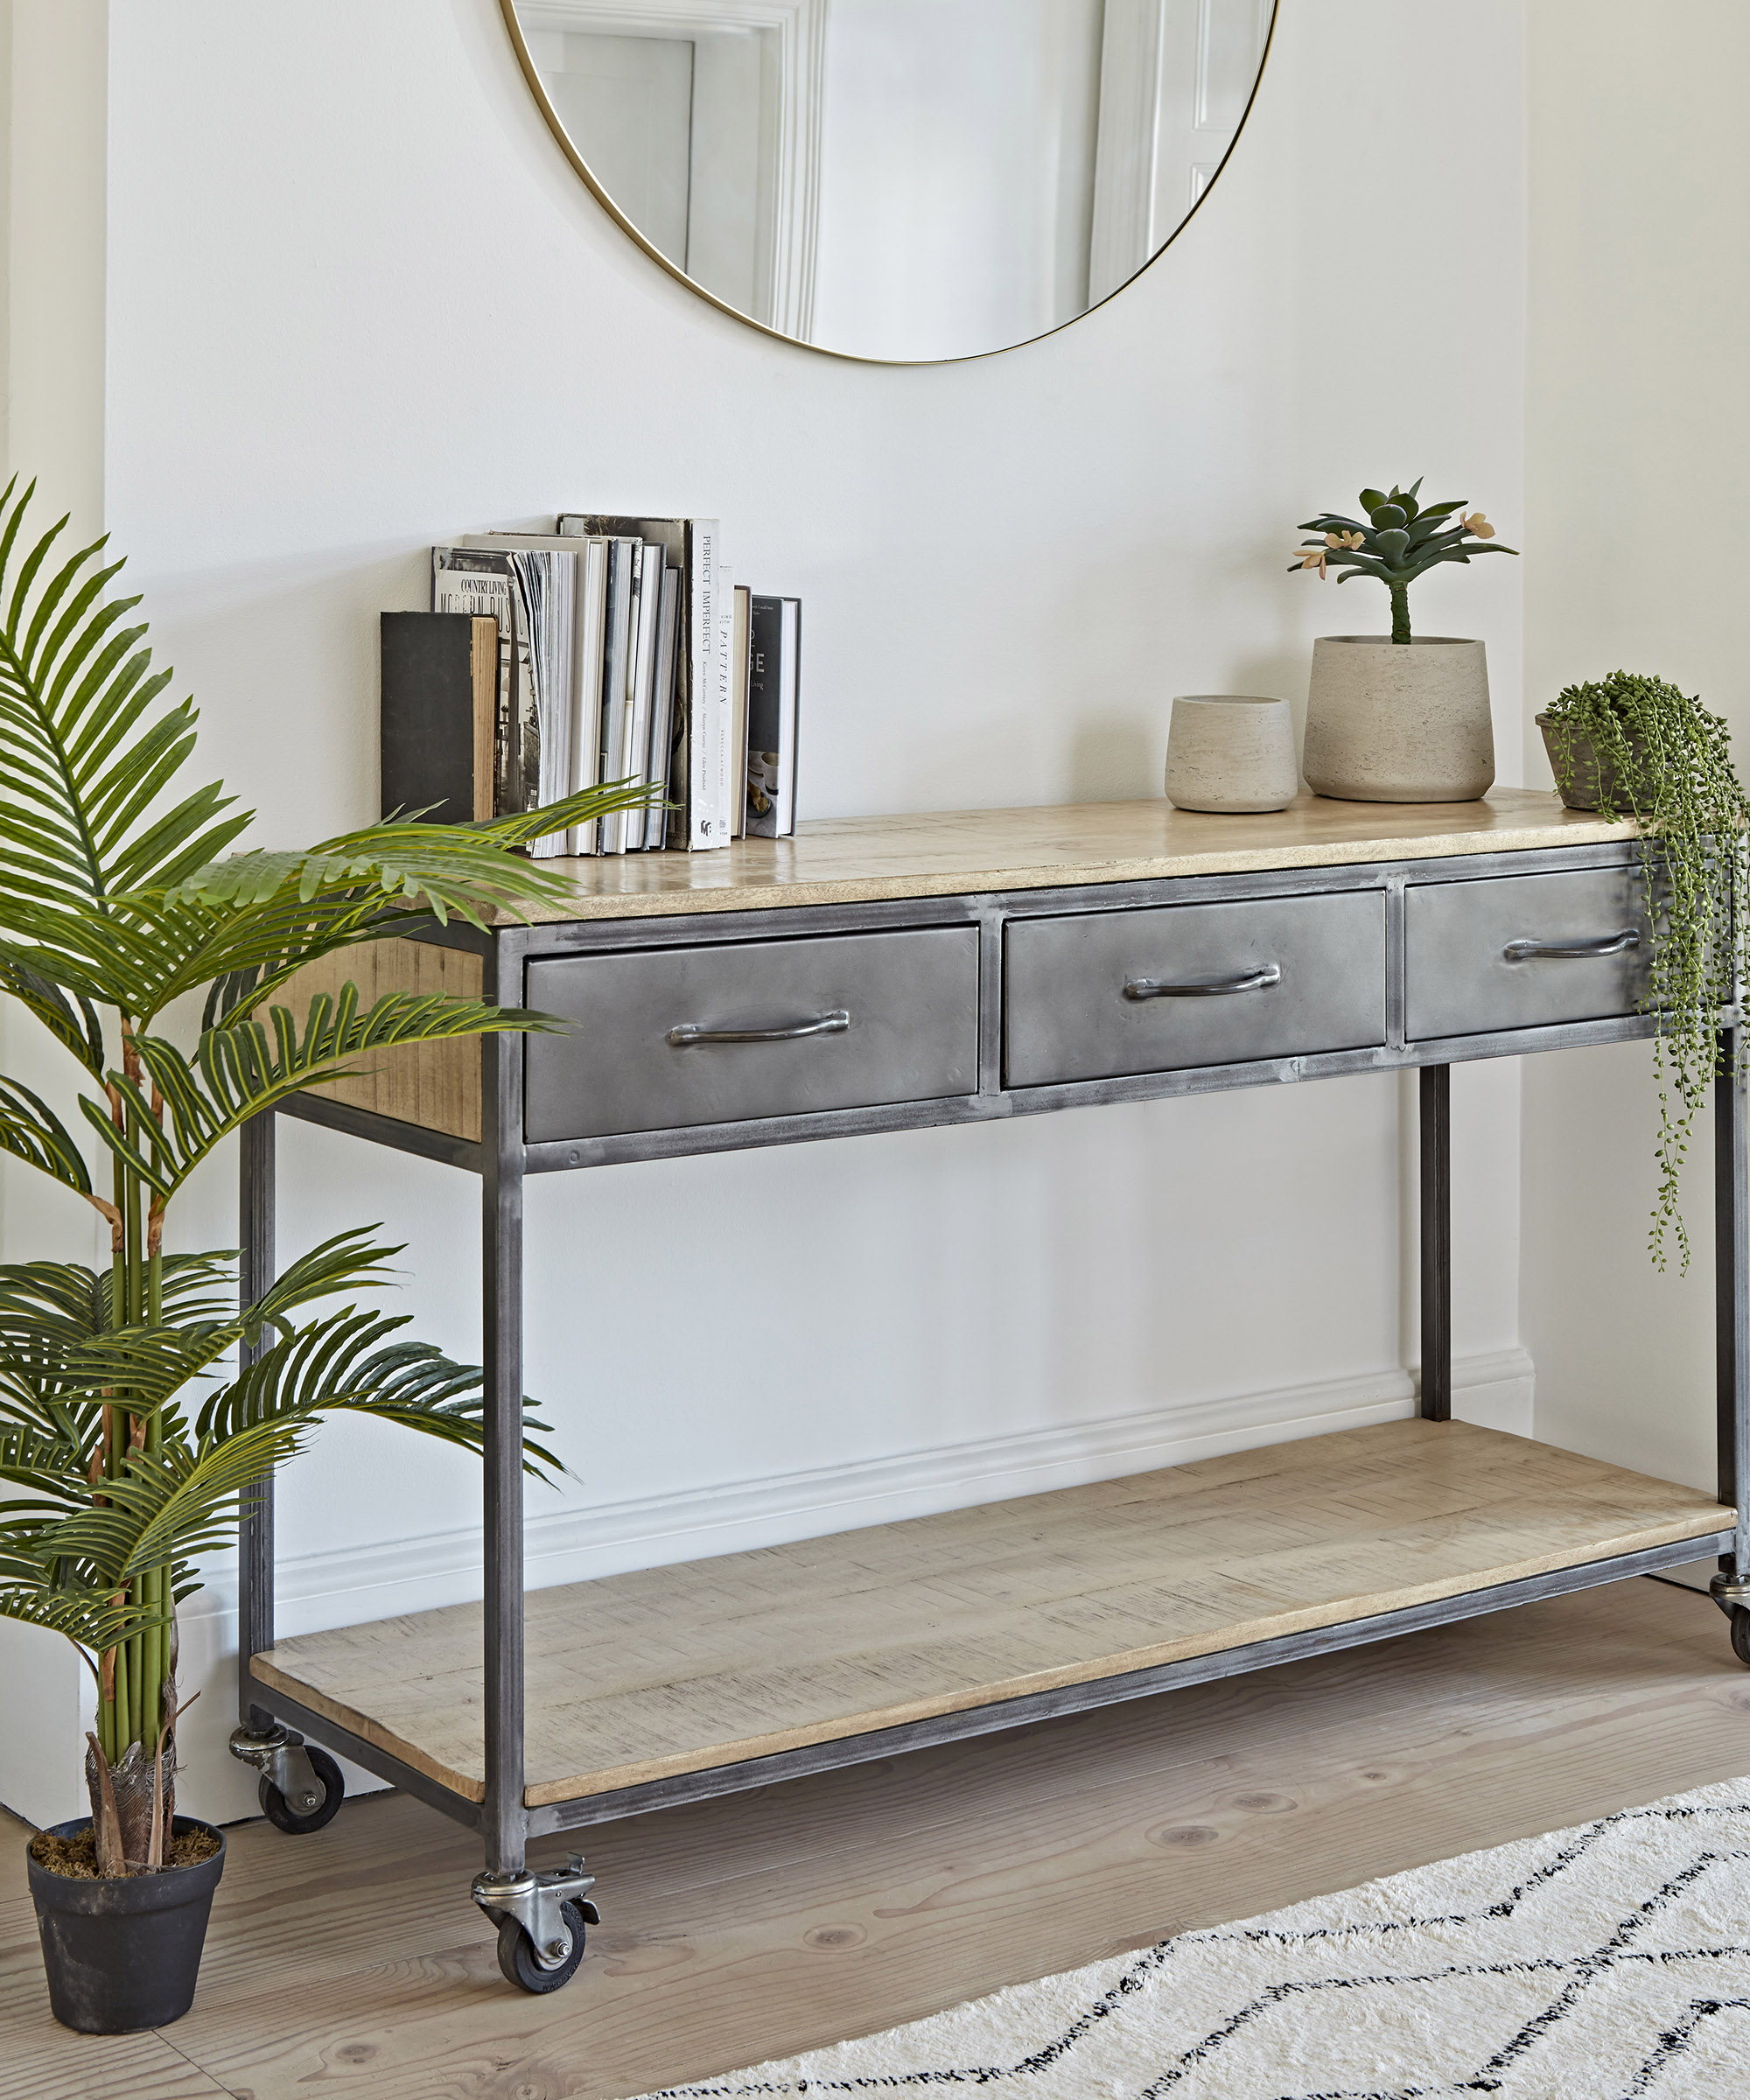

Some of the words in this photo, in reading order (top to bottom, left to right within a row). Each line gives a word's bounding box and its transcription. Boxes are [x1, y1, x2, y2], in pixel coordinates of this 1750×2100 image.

[460, 578, 488, 594] COUNTRY
[489, 580, 507, 595] LIVING
[702, 591, 710, 654] IMPERFECT
[719, 630, 728, 704] PATTERN
